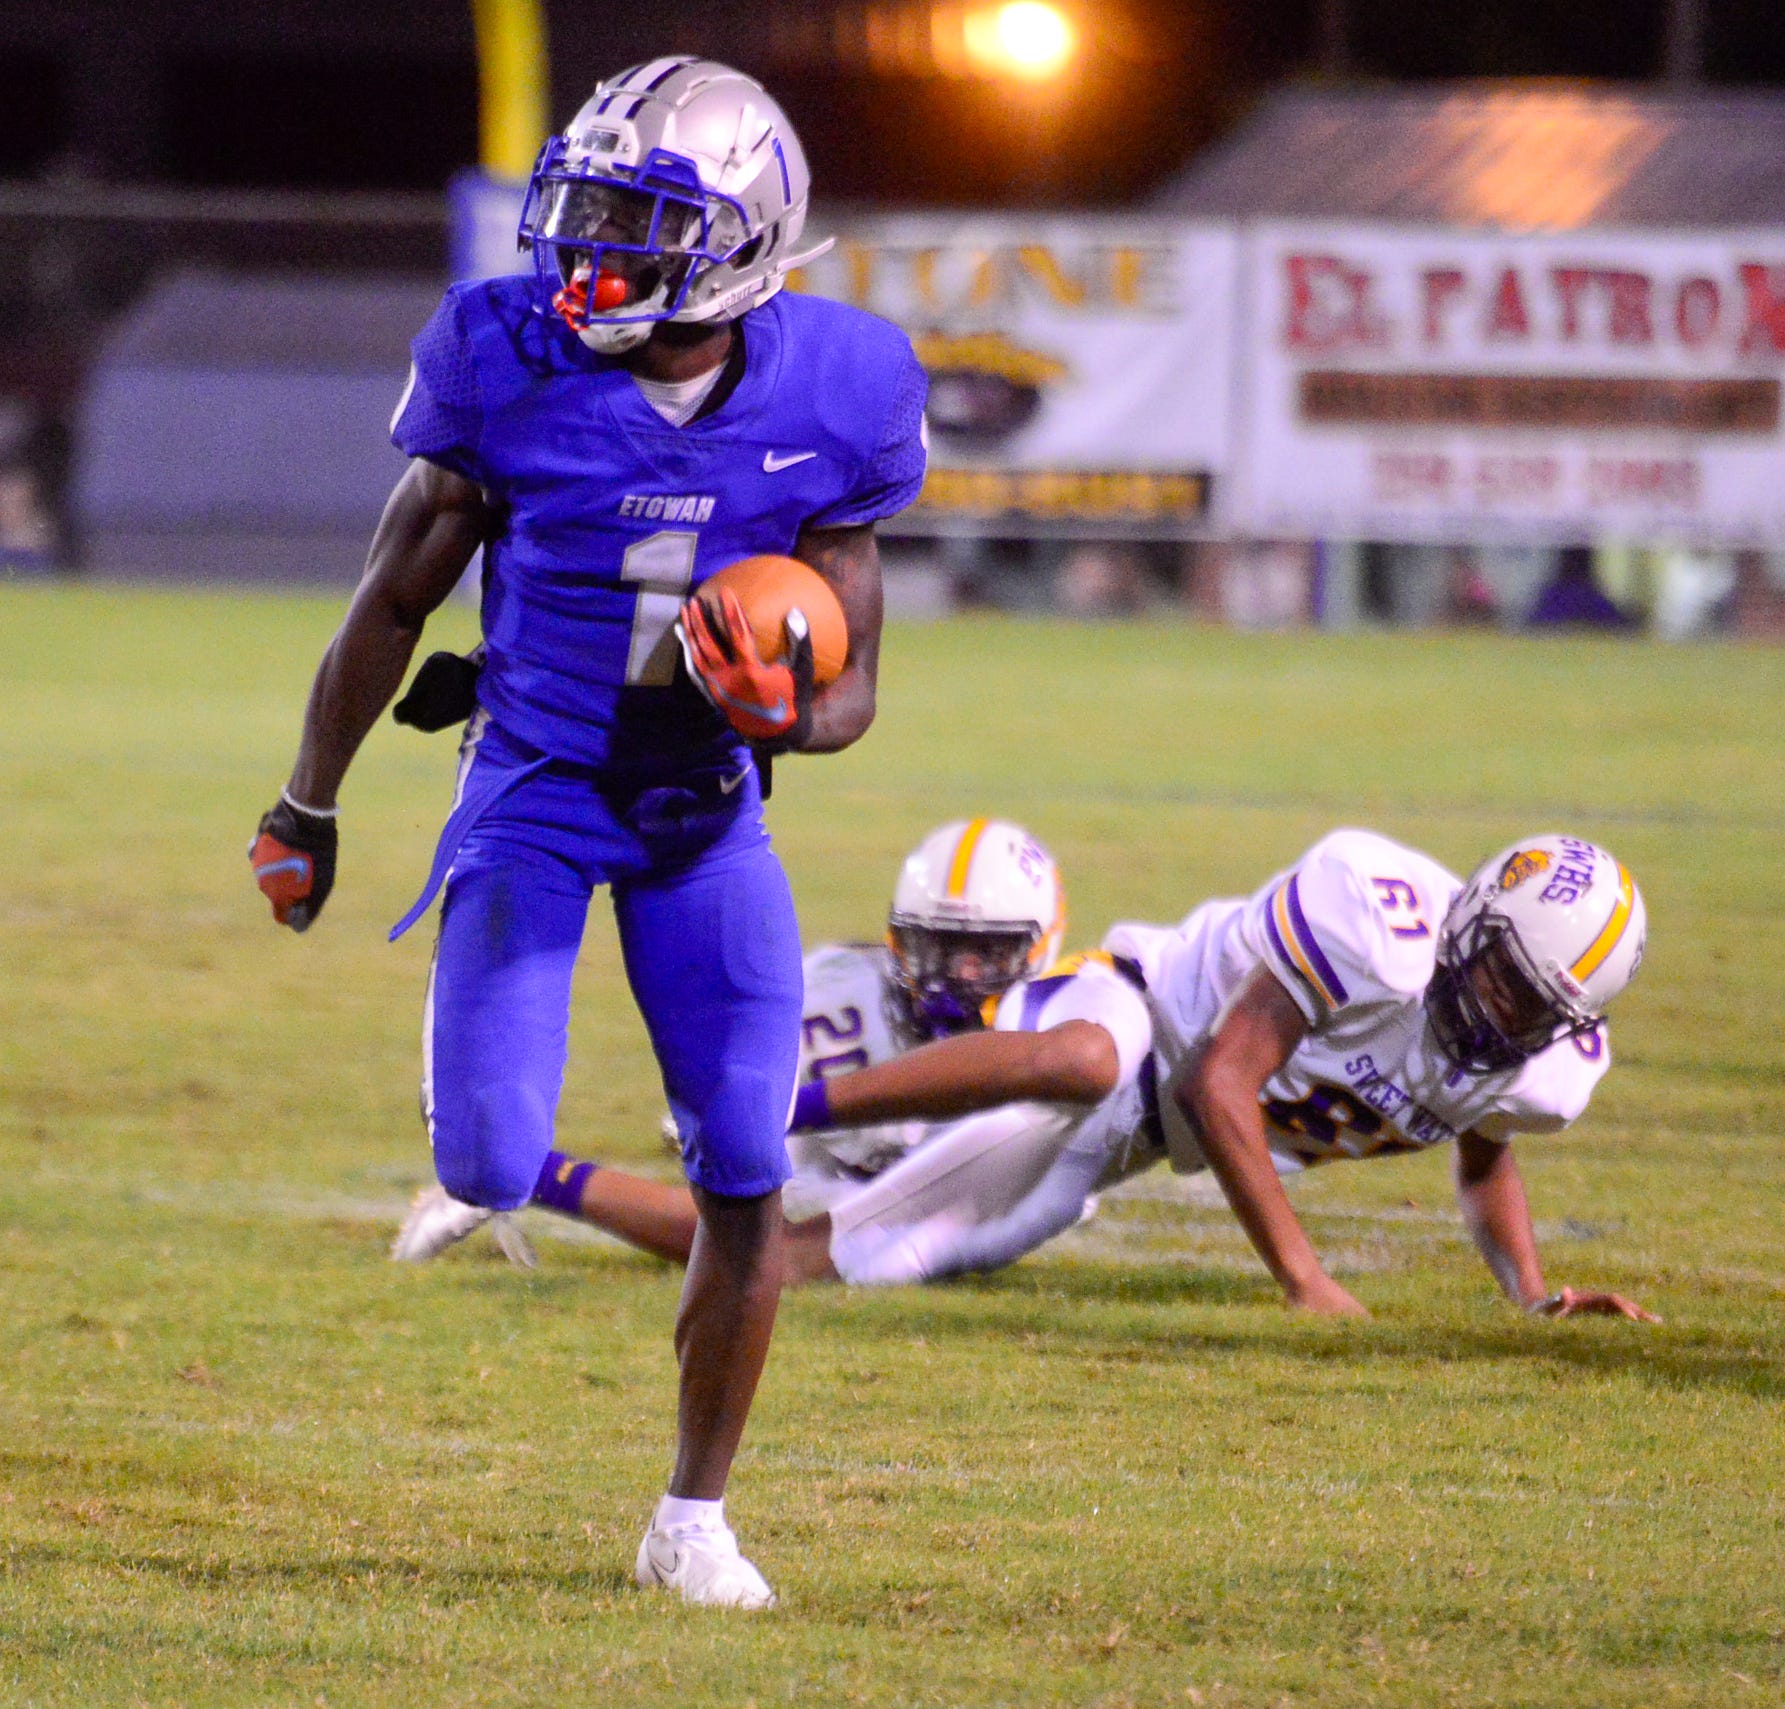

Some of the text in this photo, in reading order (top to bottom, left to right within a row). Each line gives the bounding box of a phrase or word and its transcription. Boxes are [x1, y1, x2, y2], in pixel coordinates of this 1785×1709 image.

[619, 494, 716, 524] ETOWAH
[620, 530, 699, 686] 1
[1369, 876, 1433, 940] 61
